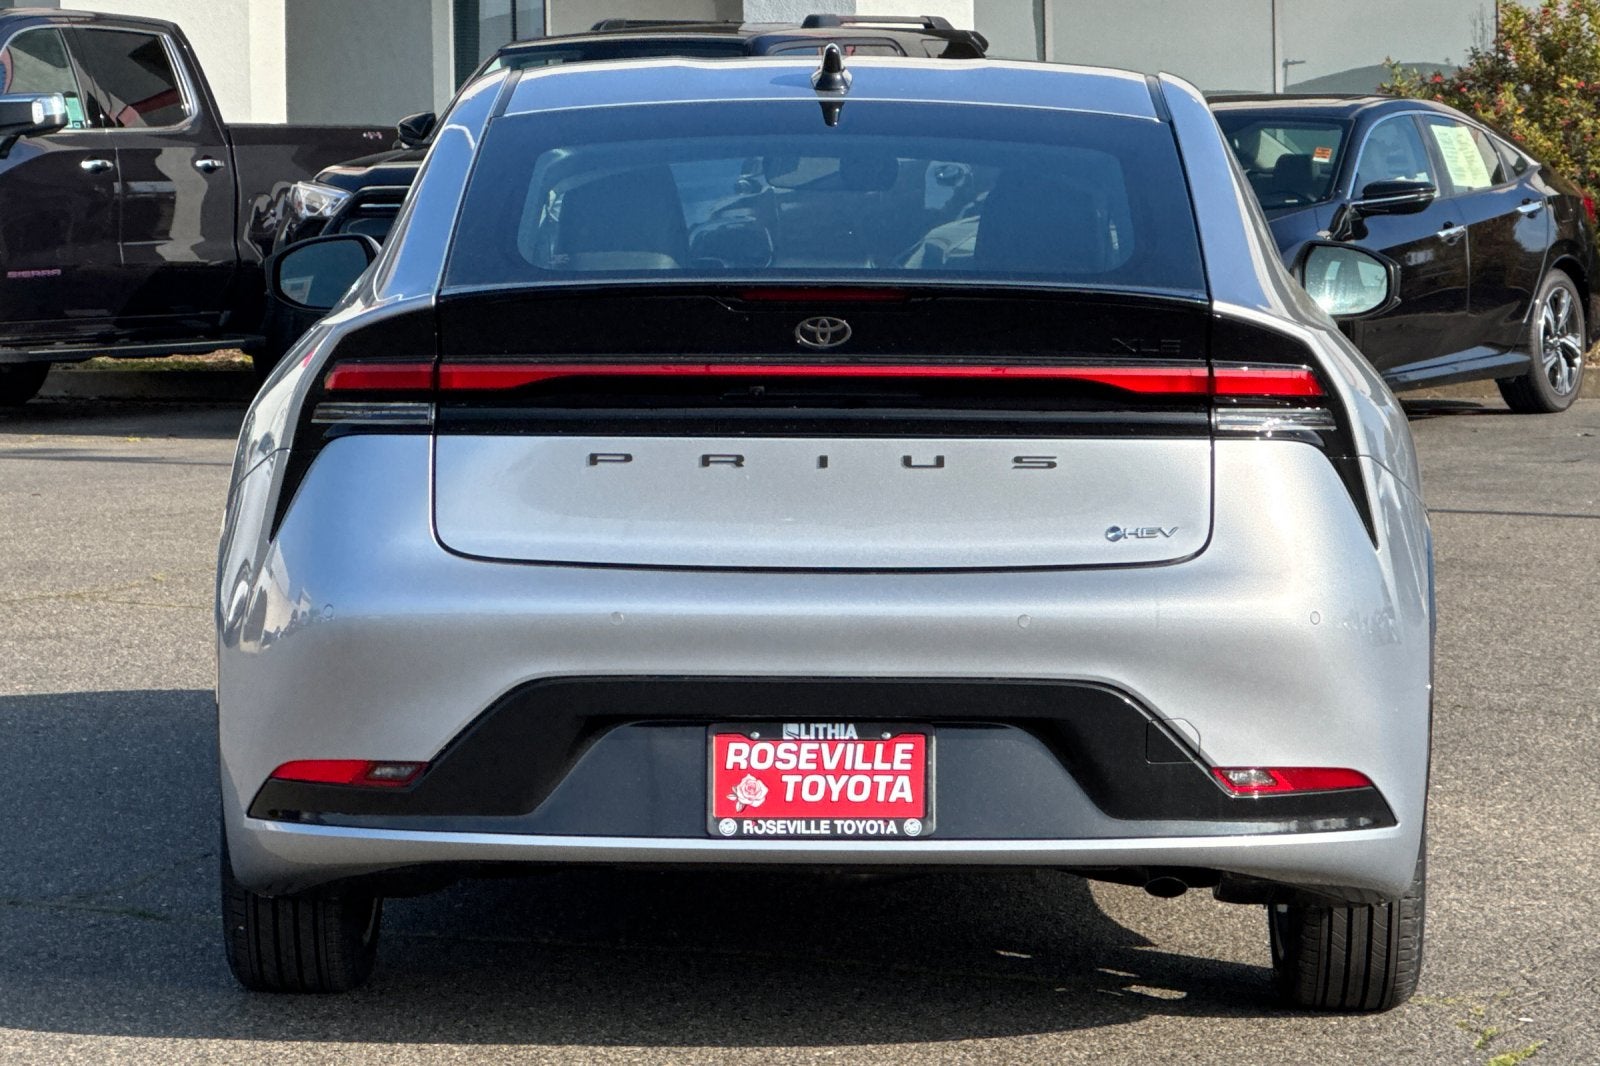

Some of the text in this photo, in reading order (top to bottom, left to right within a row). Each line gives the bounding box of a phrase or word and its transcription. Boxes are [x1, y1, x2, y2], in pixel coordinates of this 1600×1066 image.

[588, 453, 1057, 469] PRIUS
[1123, 526, 1179, 539] HEV
[800, 723, 858, 740] LITHIA
[725, 742, 914, 770] ROSEVILLE
[782, 774, 914, 803] TOYOTA
[742, 820, 898, 835] ROSEVILLE TOYOTA
